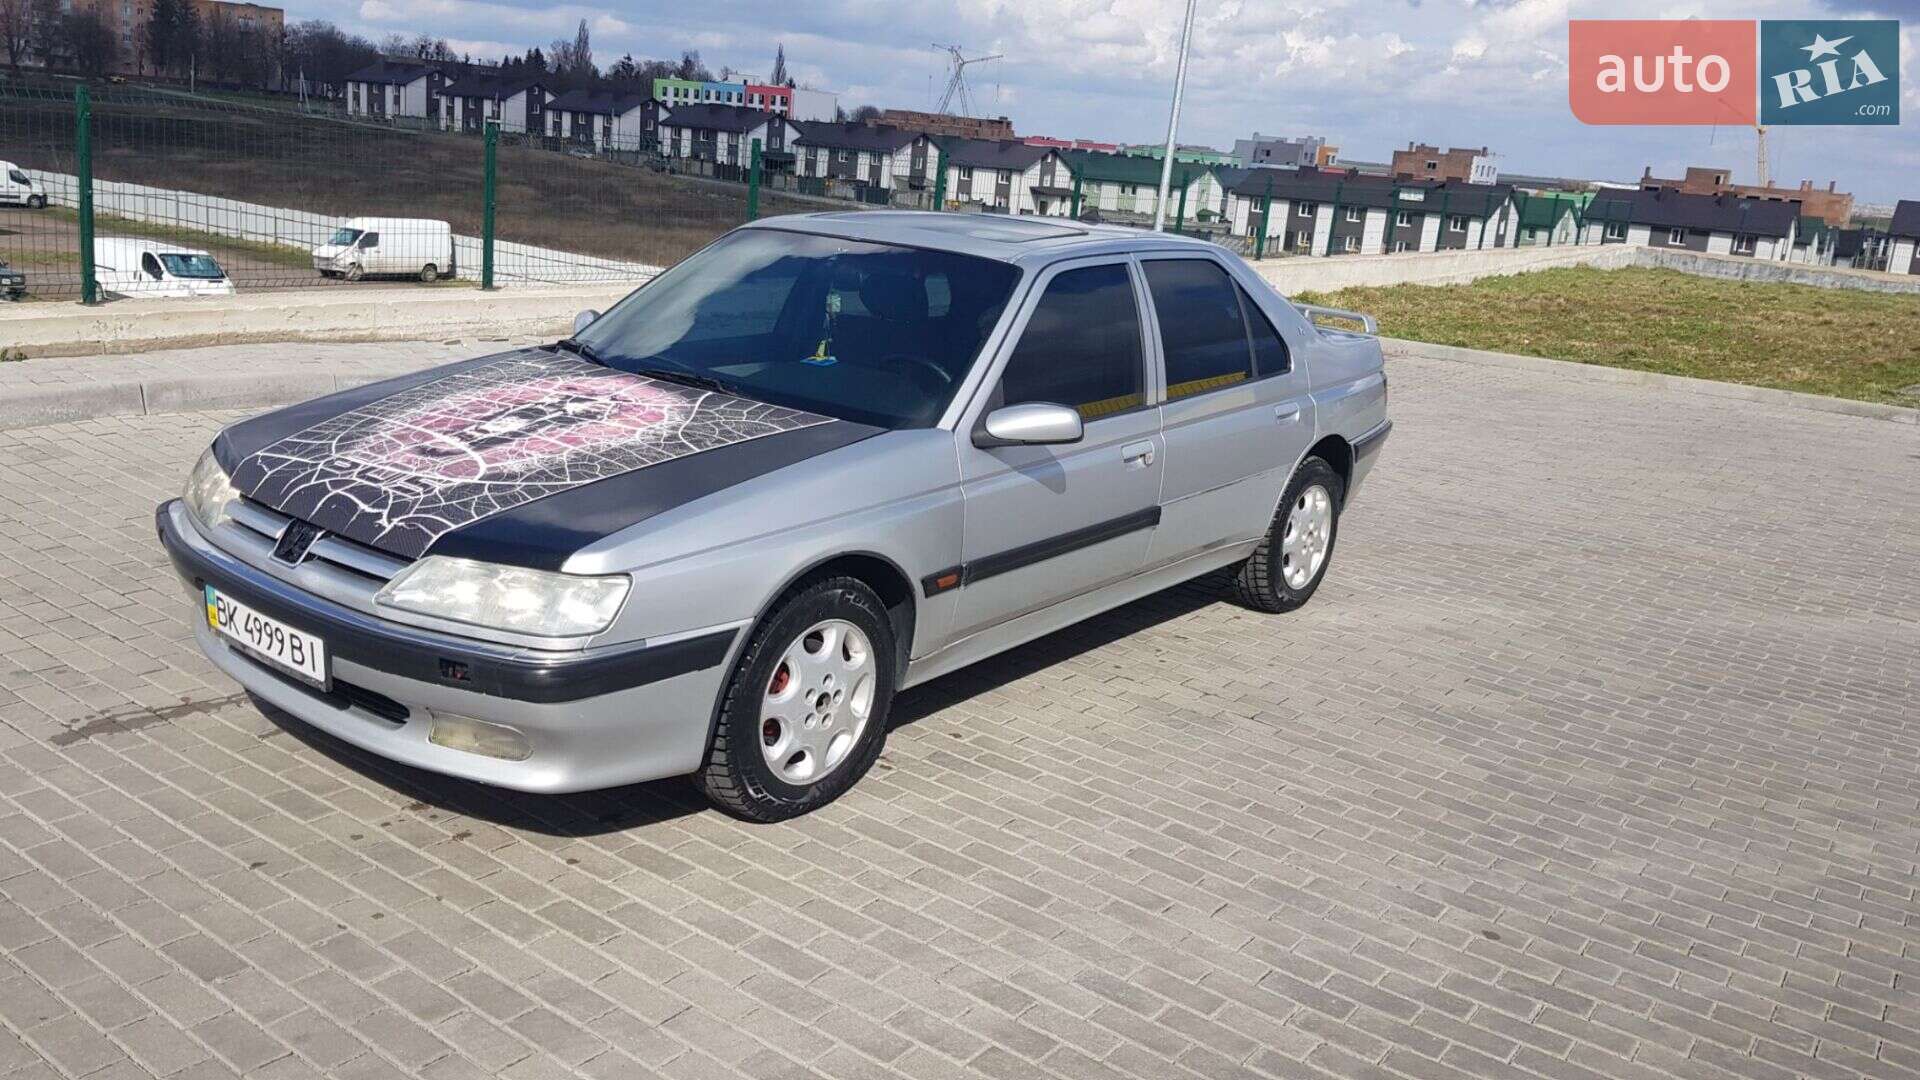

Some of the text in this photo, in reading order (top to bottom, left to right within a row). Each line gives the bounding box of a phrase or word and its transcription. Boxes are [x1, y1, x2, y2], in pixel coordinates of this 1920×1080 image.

[215, 596, 316, 673] BK 4999 BI
